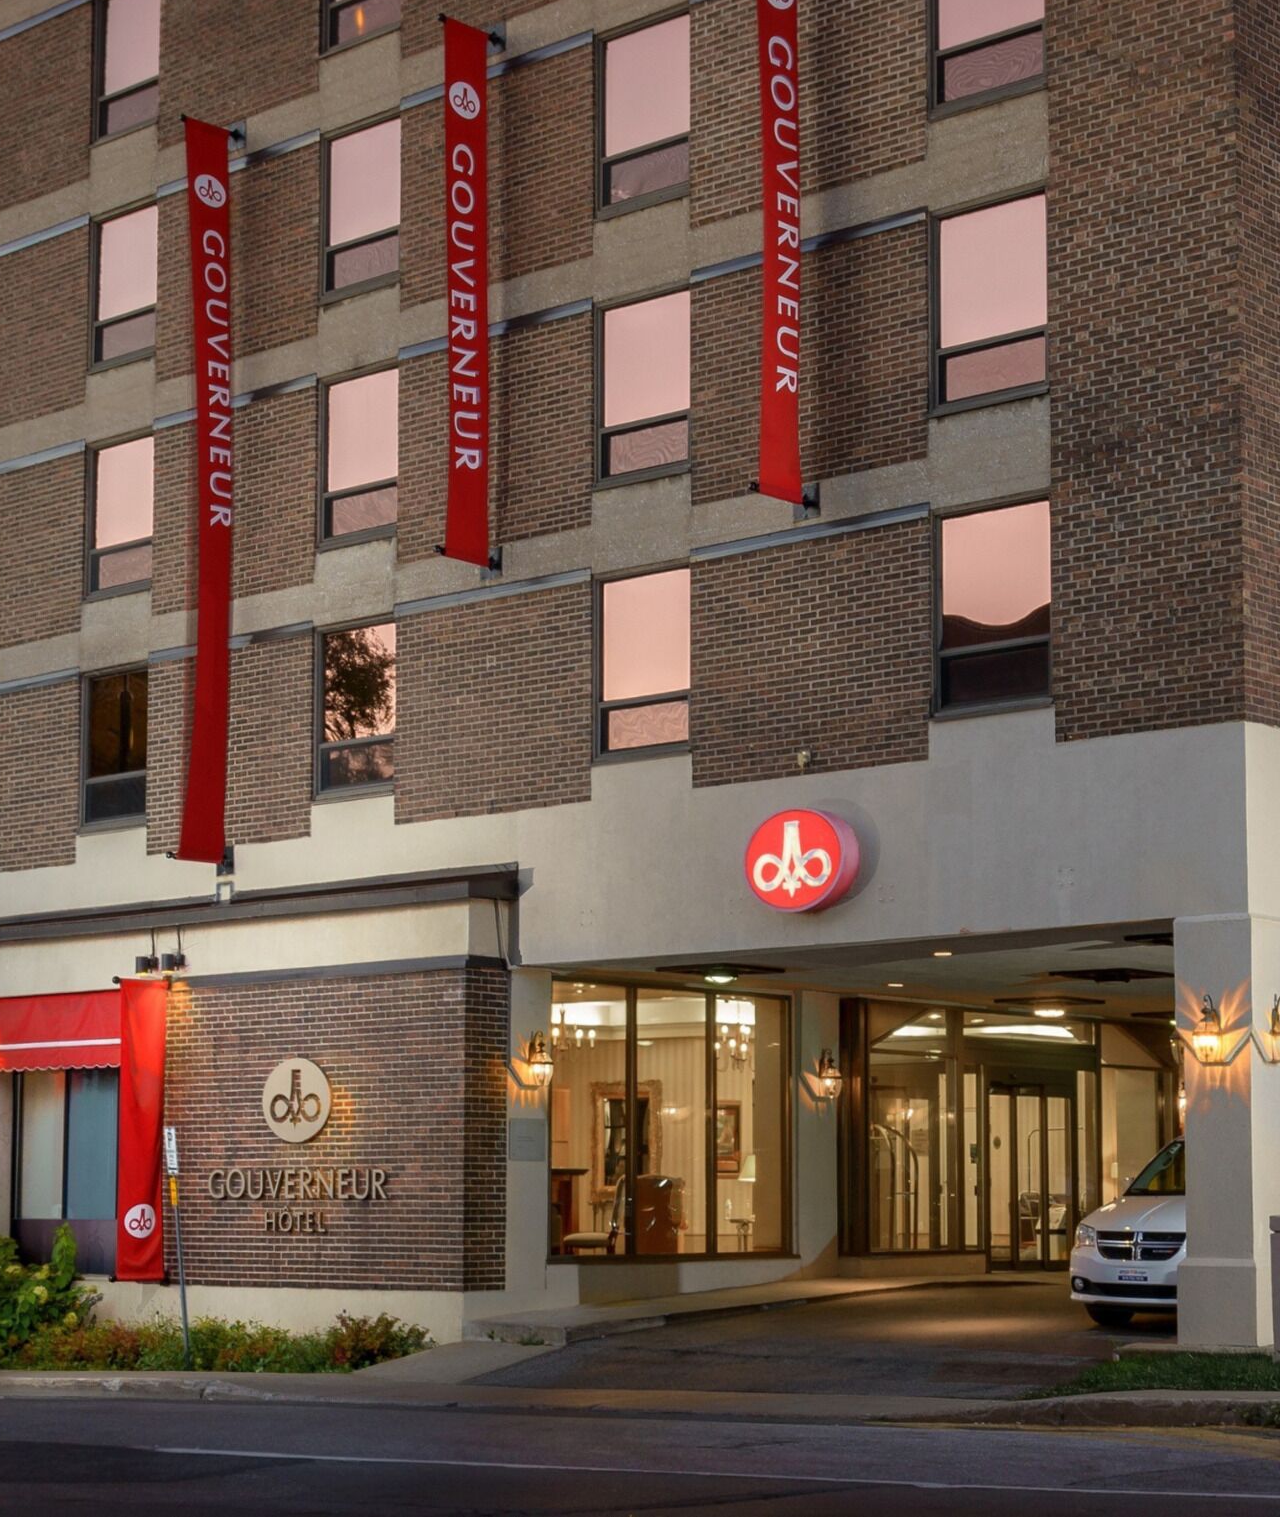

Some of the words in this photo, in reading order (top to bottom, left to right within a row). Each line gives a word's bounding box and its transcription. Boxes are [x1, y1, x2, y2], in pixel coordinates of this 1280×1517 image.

[451, 143, 482, 471] GOUVERNEUR
[768, 35, 800, 394] GOUVERNEUR
[202, 229, 232, 528] GOUVERNEUR
[207, 1168, 387, 1200] GOUVERNEUR
[263, 1206, 327, 1234] HÔTEL
